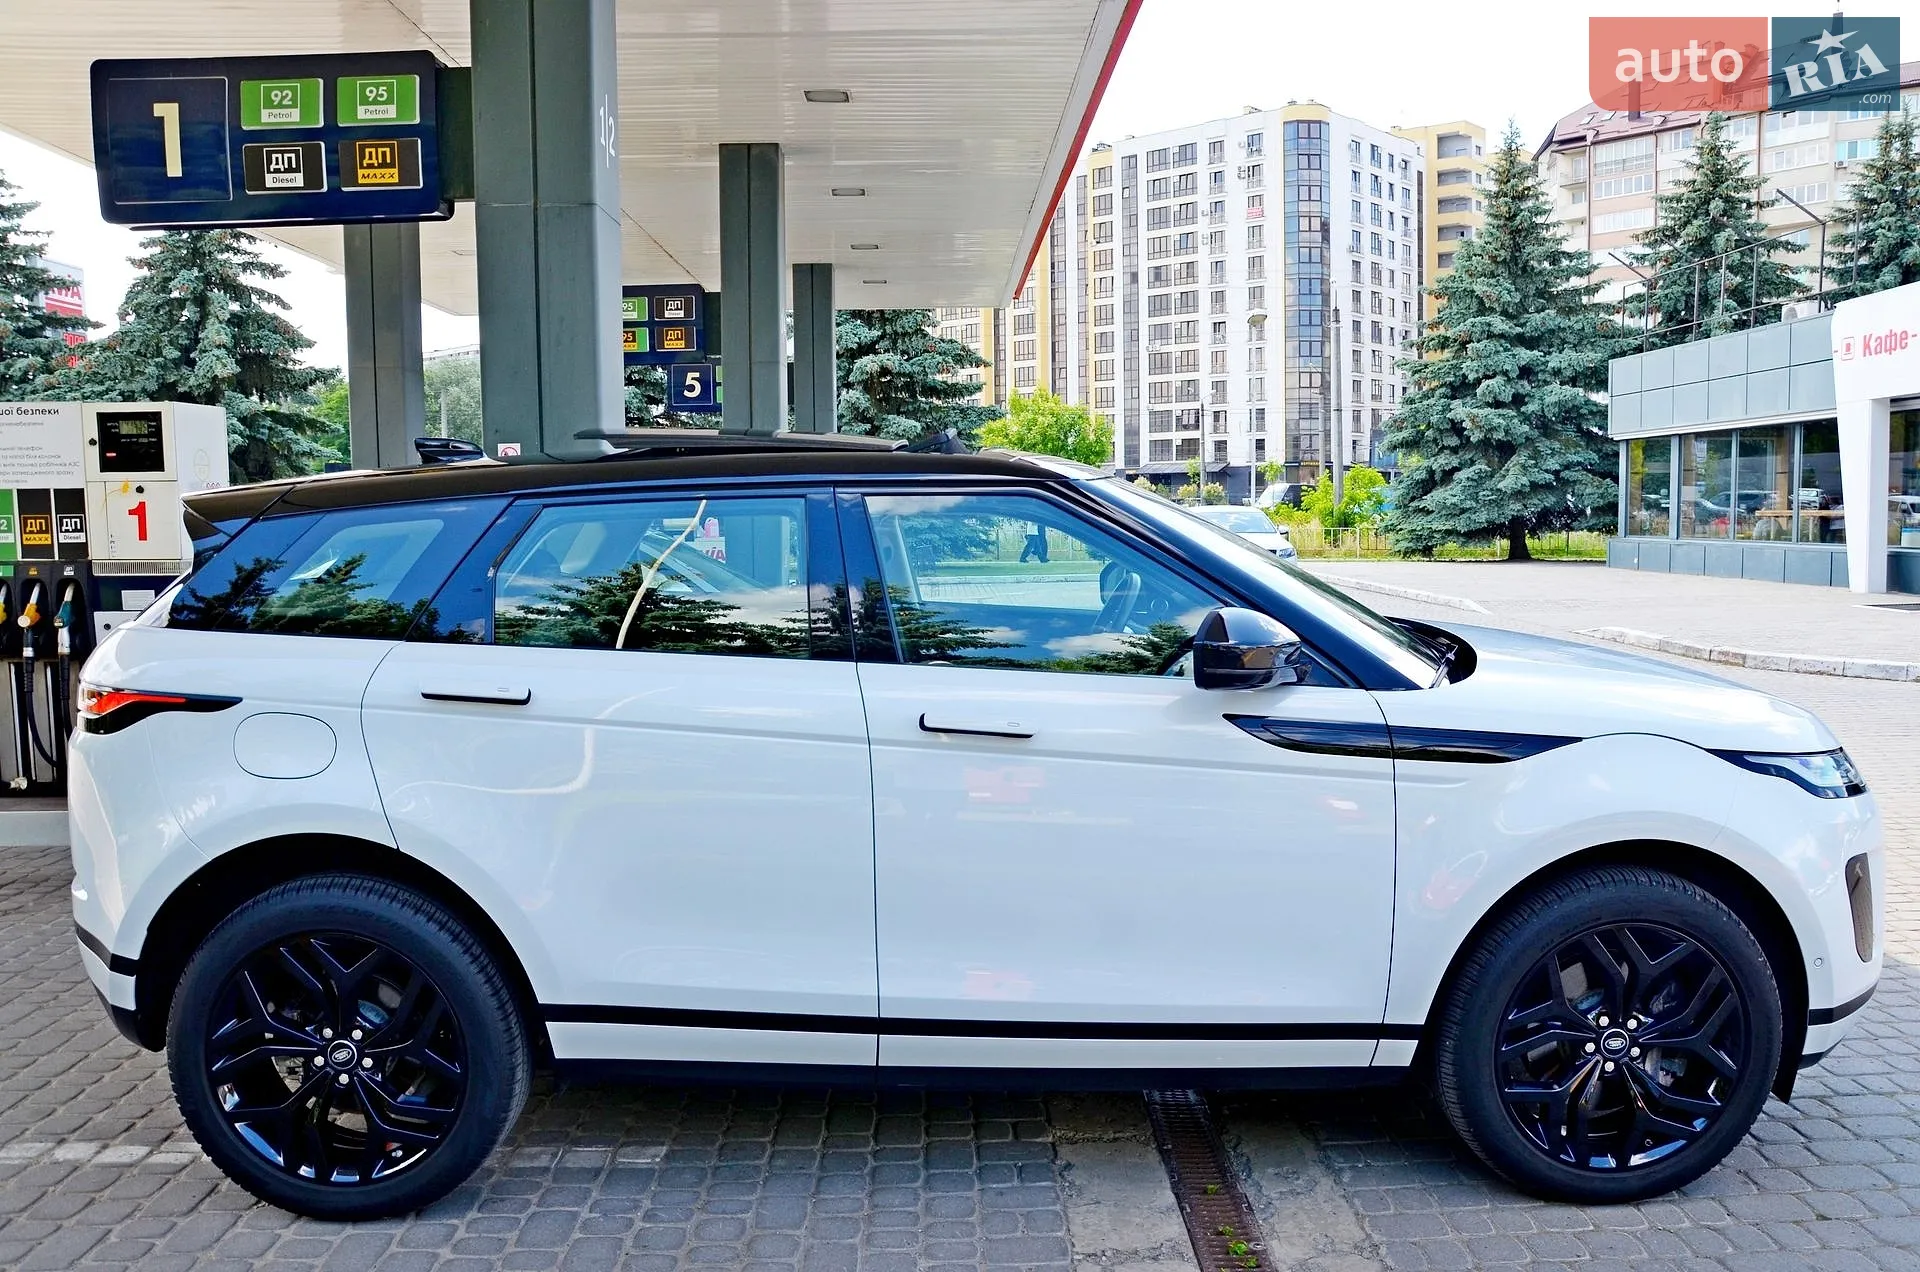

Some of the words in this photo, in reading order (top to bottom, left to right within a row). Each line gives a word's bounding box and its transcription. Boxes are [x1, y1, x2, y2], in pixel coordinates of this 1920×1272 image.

[270, 89, 293, 106] 92
[365, 86, 388, 102] 95
[267, 111, 293, 119] Petrol
[364, 107, 389, 115] Petrol
[153, 102, 183, 178] 1
[269, 152, 297, 172] ДП
[362, 147, 391, 167] ДП
[272, 176, 297, 184] Diesel
[622, 302, 633, 311] 95
[666, 300, 681, 311] ДП
[666, 330, 681, 341] ДП
[683, 372, 701, 398] 5
[16, 406, 60, 416] безпеки
[26, 519, 46, 533] ДП
[61, 518, 81, 532] ДП
[128, 501, 148, 541] 1
